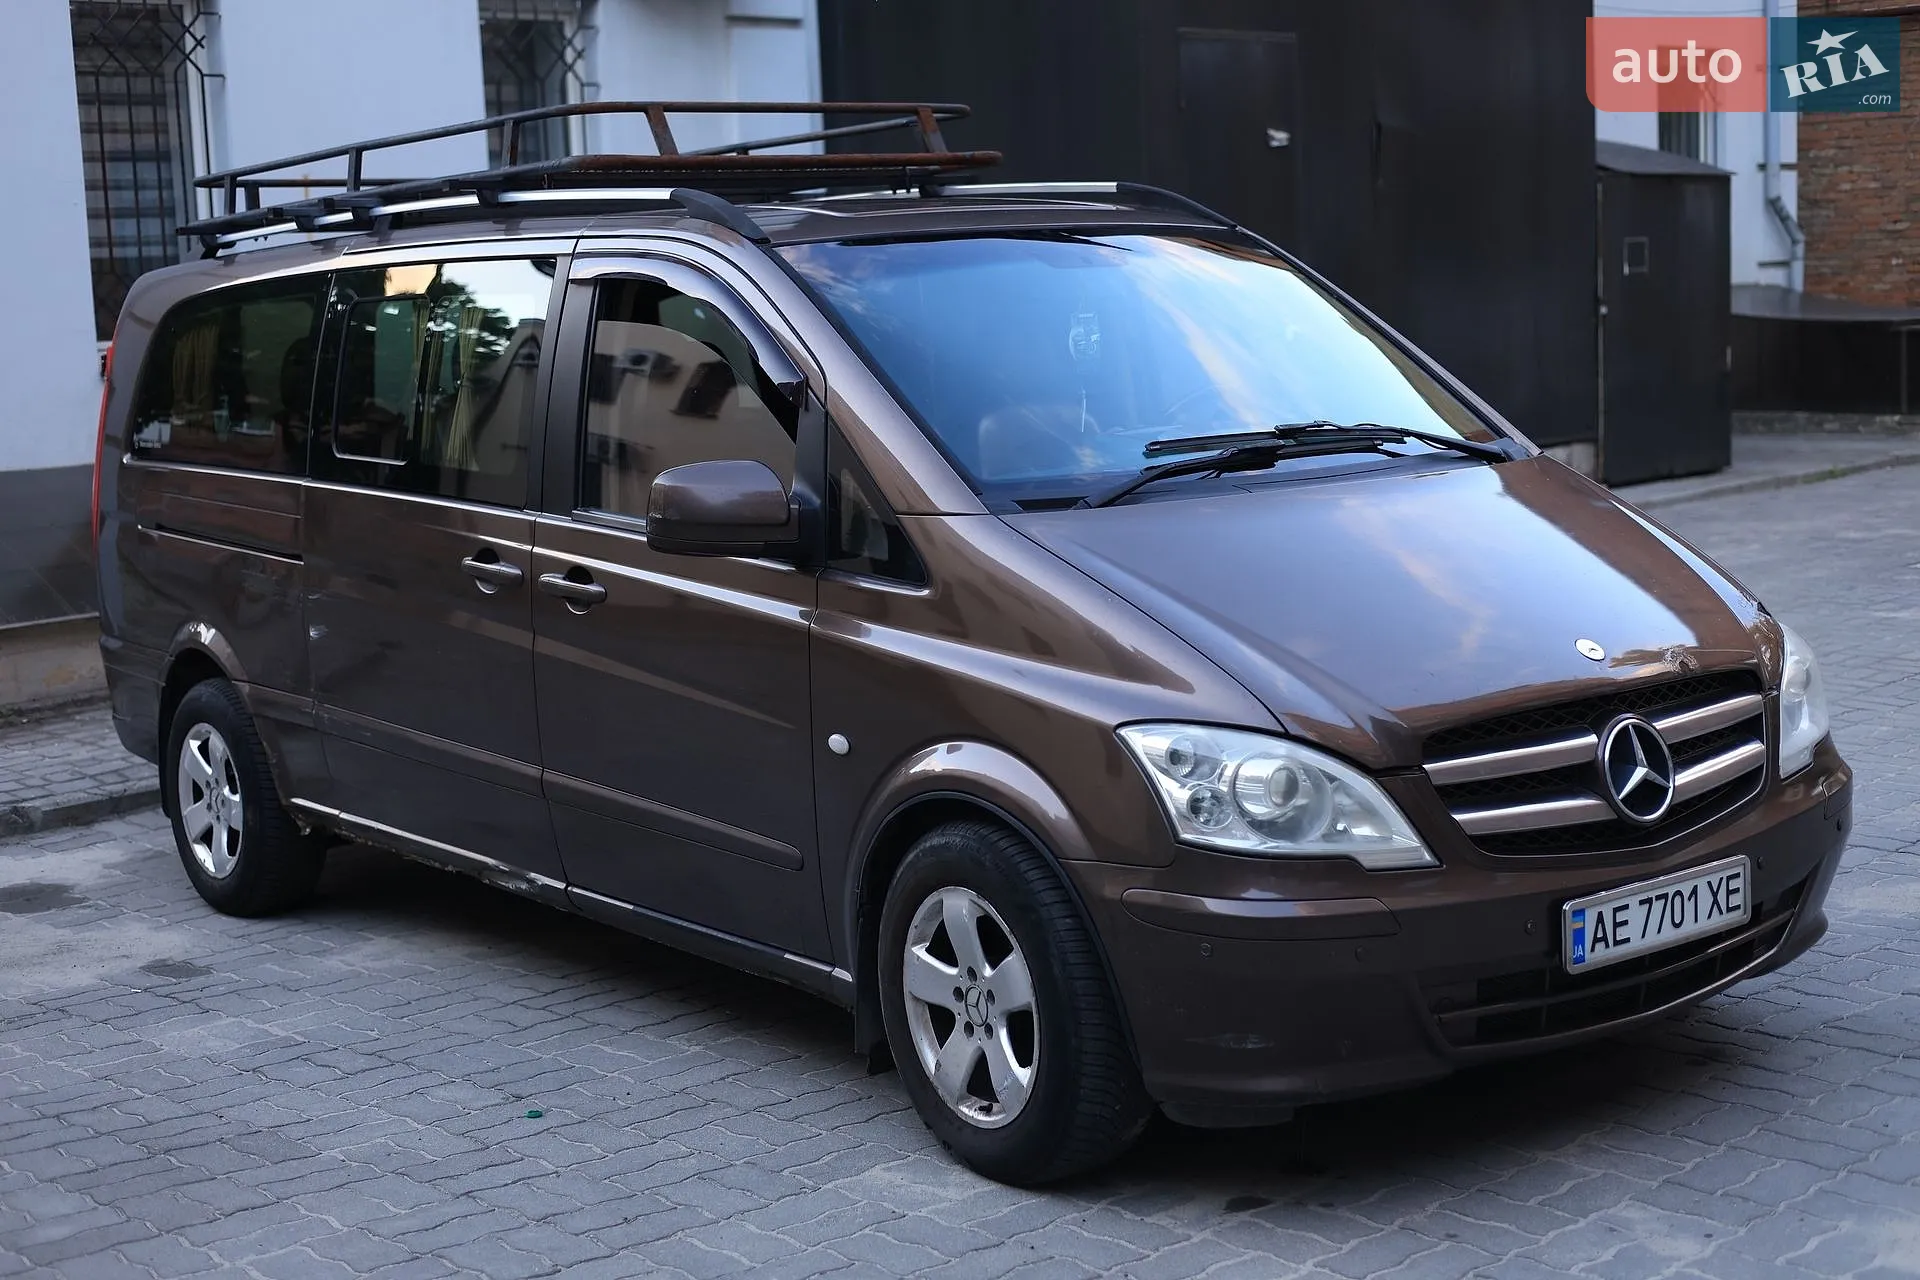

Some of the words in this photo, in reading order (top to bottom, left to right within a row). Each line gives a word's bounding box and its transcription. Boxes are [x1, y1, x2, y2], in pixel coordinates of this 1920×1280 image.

[1590, 903, 1631, 953] AE
[1639, 884, 1699, 939] 7701
[1706, 871, 1742, 921] XE
